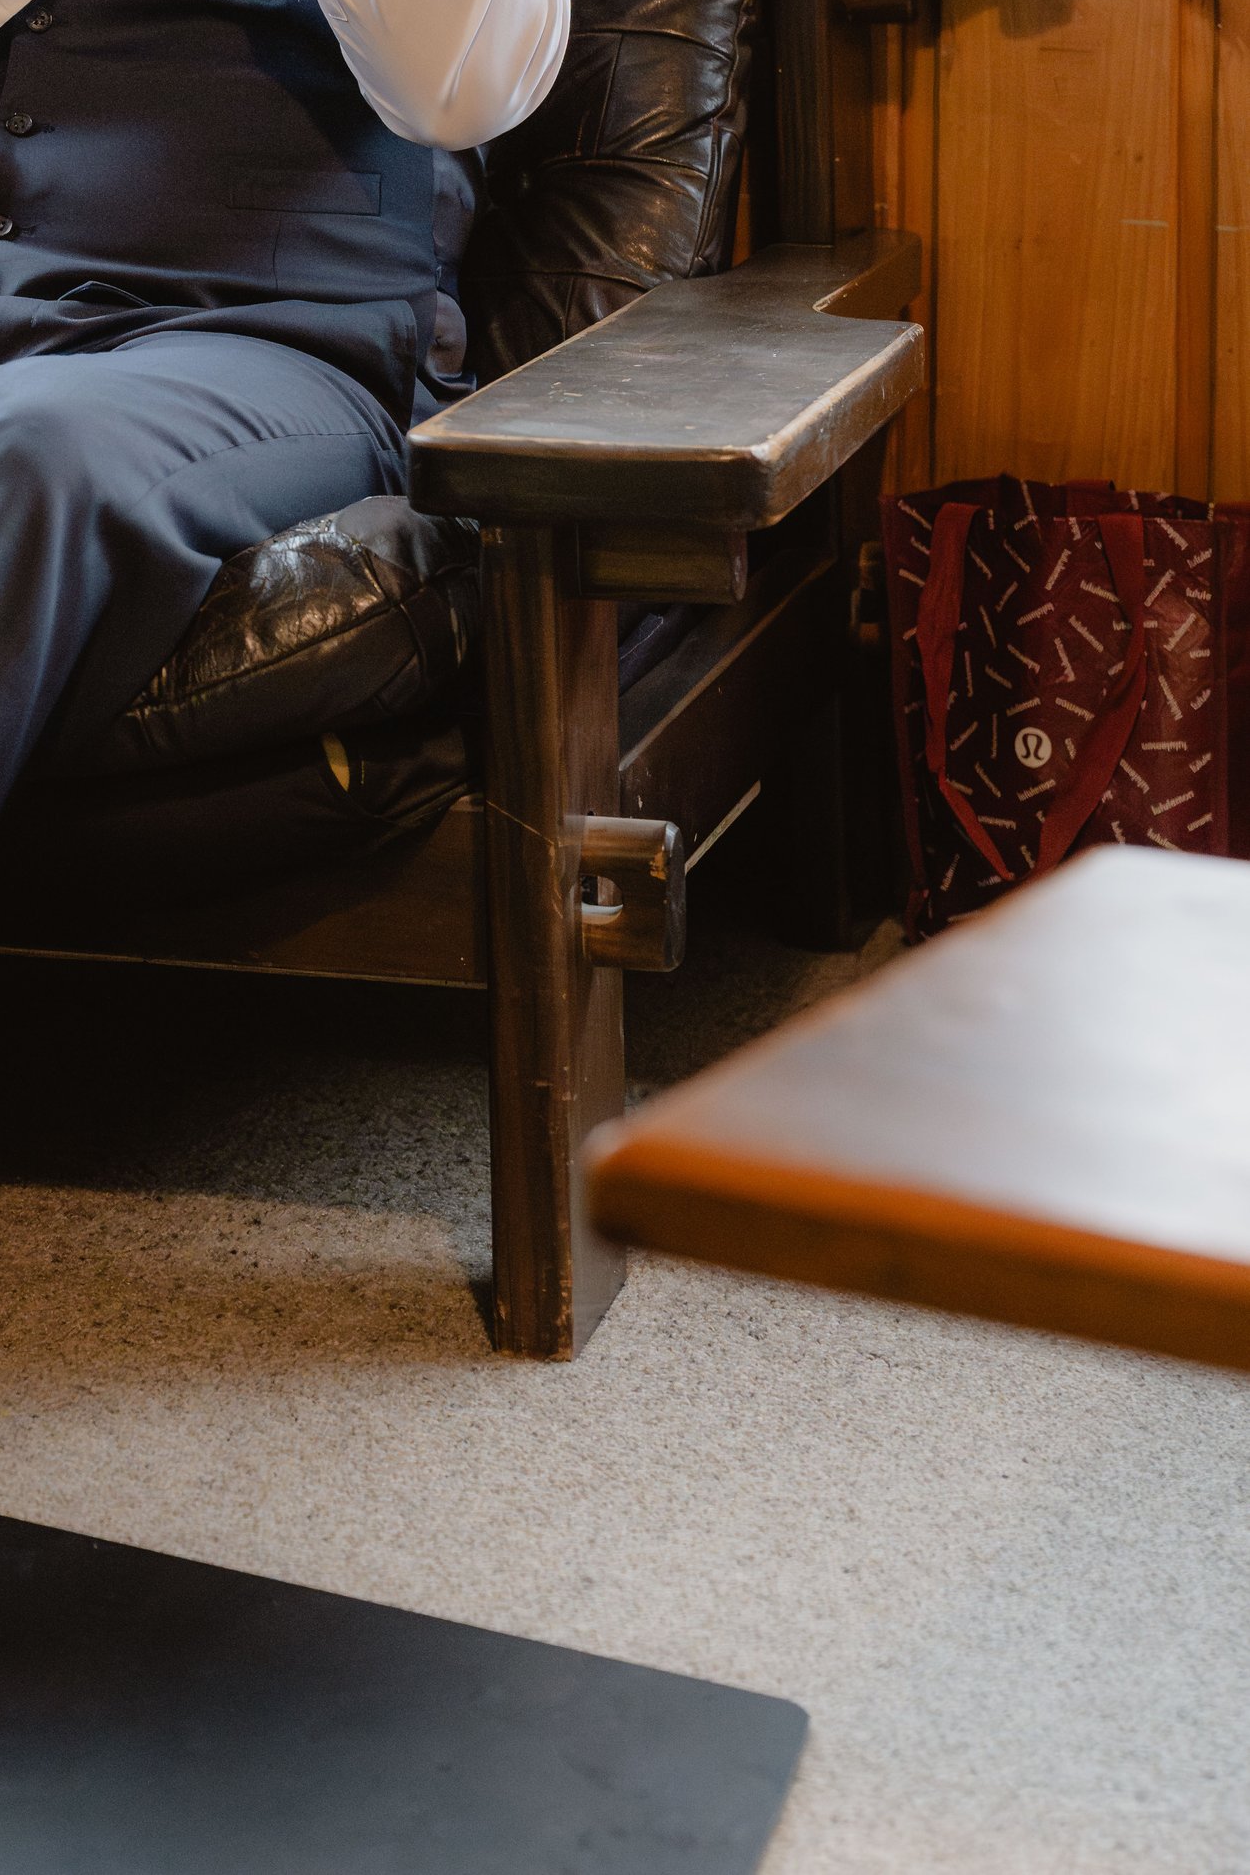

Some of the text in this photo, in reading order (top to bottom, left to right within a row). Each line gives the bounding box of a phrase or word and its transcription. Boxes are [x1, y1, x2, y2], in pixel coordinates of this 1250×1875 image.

[1080, 579, 1120, 603] lululemo
[1141, 740, 1188, 752] lululemon
[1151, 790, 1194, 816] lululemon
